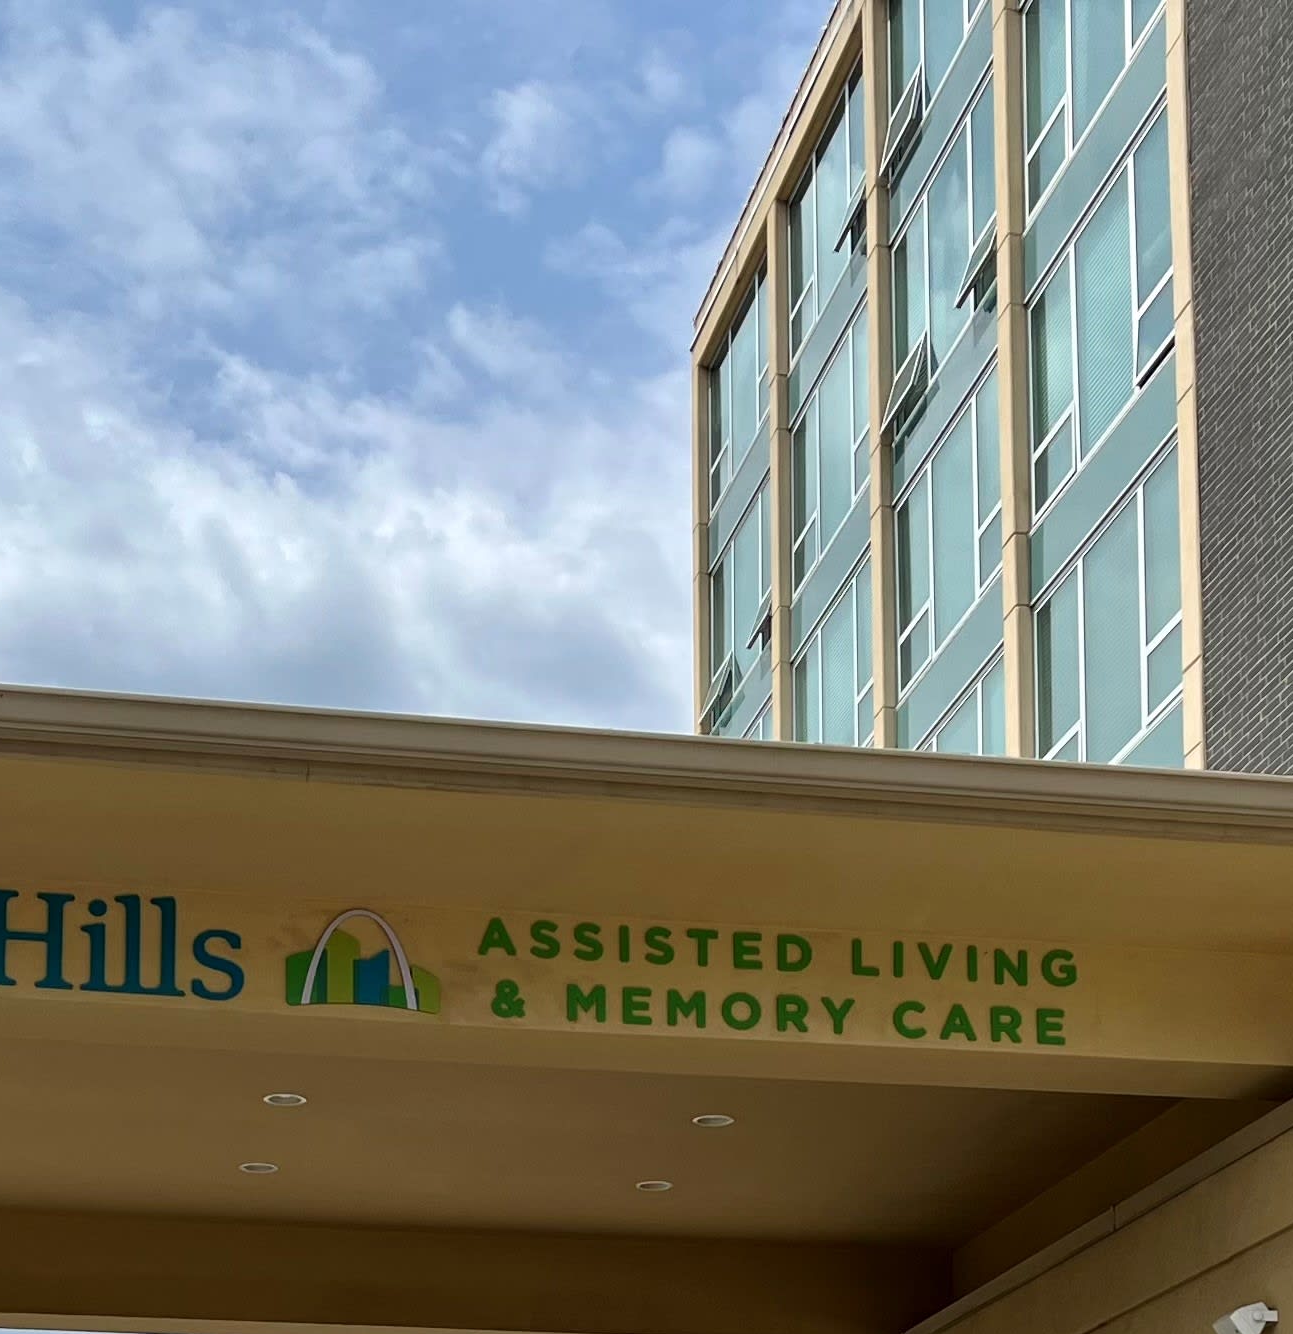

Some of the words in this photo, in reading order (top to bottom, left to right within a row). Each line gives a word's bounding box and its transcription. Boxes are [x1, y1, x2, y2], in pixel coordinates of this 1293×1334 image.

[478, 917, 813, 974] ASSISTED
[851, 938, 1078, 988] LIVING
[490, 979, 526, 1019] &
[567, 984, 856, 1036] MEMORY
[892, 1001, 1067, 1046] CARE
